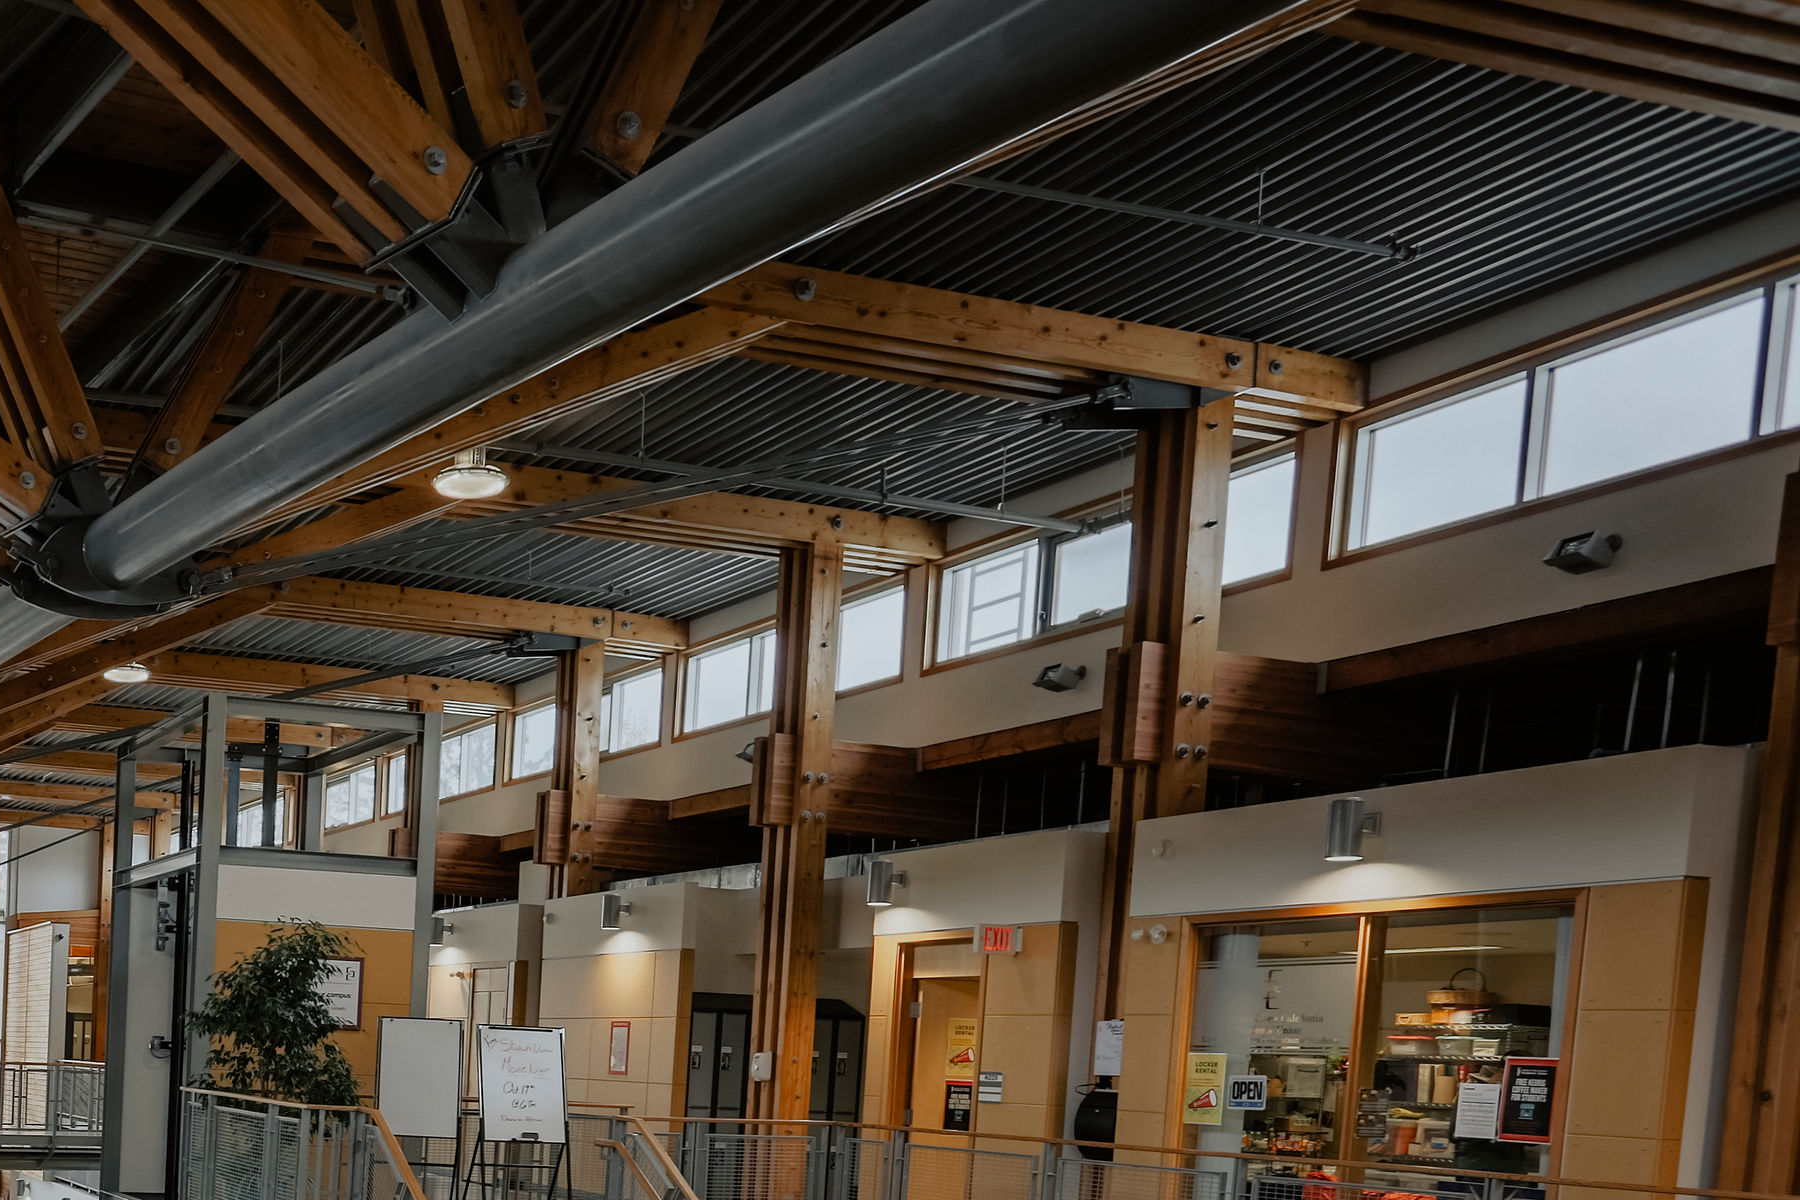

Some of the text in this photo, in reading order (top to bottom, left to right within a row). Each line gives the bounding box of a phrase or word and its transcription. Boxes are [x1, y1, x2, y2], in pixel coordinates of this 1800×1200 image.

[984, 927, 1012, 951] EXIT
[1232, 1081, 1263, 1100] OPEN
[1510, 1093, 1547, 1102] FOR STUDENTS
